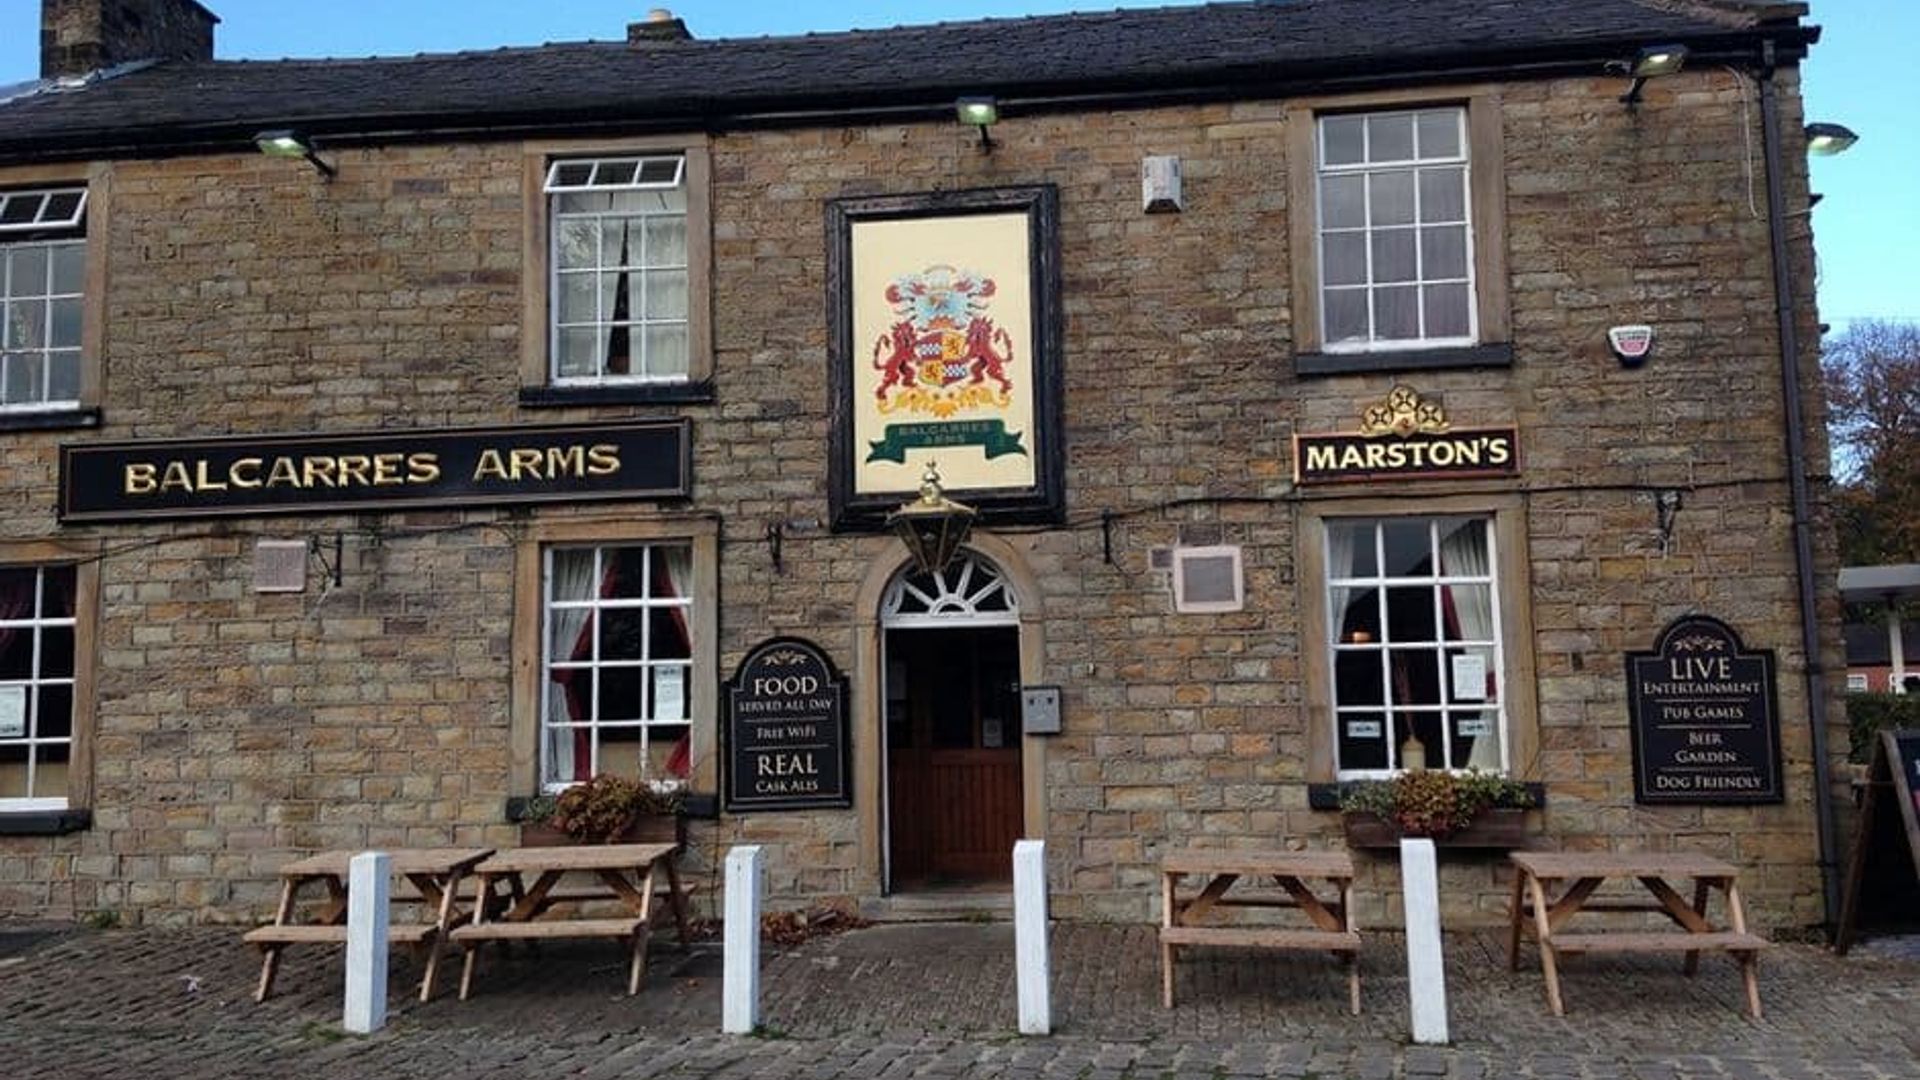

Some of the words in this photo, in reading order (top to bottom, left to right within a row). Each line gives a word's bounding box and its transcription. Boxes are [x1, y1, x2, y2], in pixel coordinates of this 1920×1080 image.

[1306, 437, 1509, 470] MARSTON'S
[125, 452, 441, 495] BALCARRES
[473, 444, 621, 482] ARMS
[1671, 656, 1732, 680] LIVE
[754, 676, 818, 696] FOOD
[1644, 682, 1760, 695] ENTERTAINMENT
[739, 701, 782, 713] SERVED
[785, 700, 804, 712] ALL
[809, 698, 833, 711] DAY
[1663, 706, 1690, 719] PUB
[1694, 705, 1744, 719] GAMES
[757, 727, 784, 740] FREE
[1689, 732, 1723, 745] BEER
[1675, 749, 1737, 763] GARDEN
[757, 752, 819, 776] REAL
[755, 781, 788, 793] CASK
[790, 780, 819, 792] ALES
[1656, 775, 1690, 789] DOG
[1695, 774, 1762, 789] FRIENDLY
